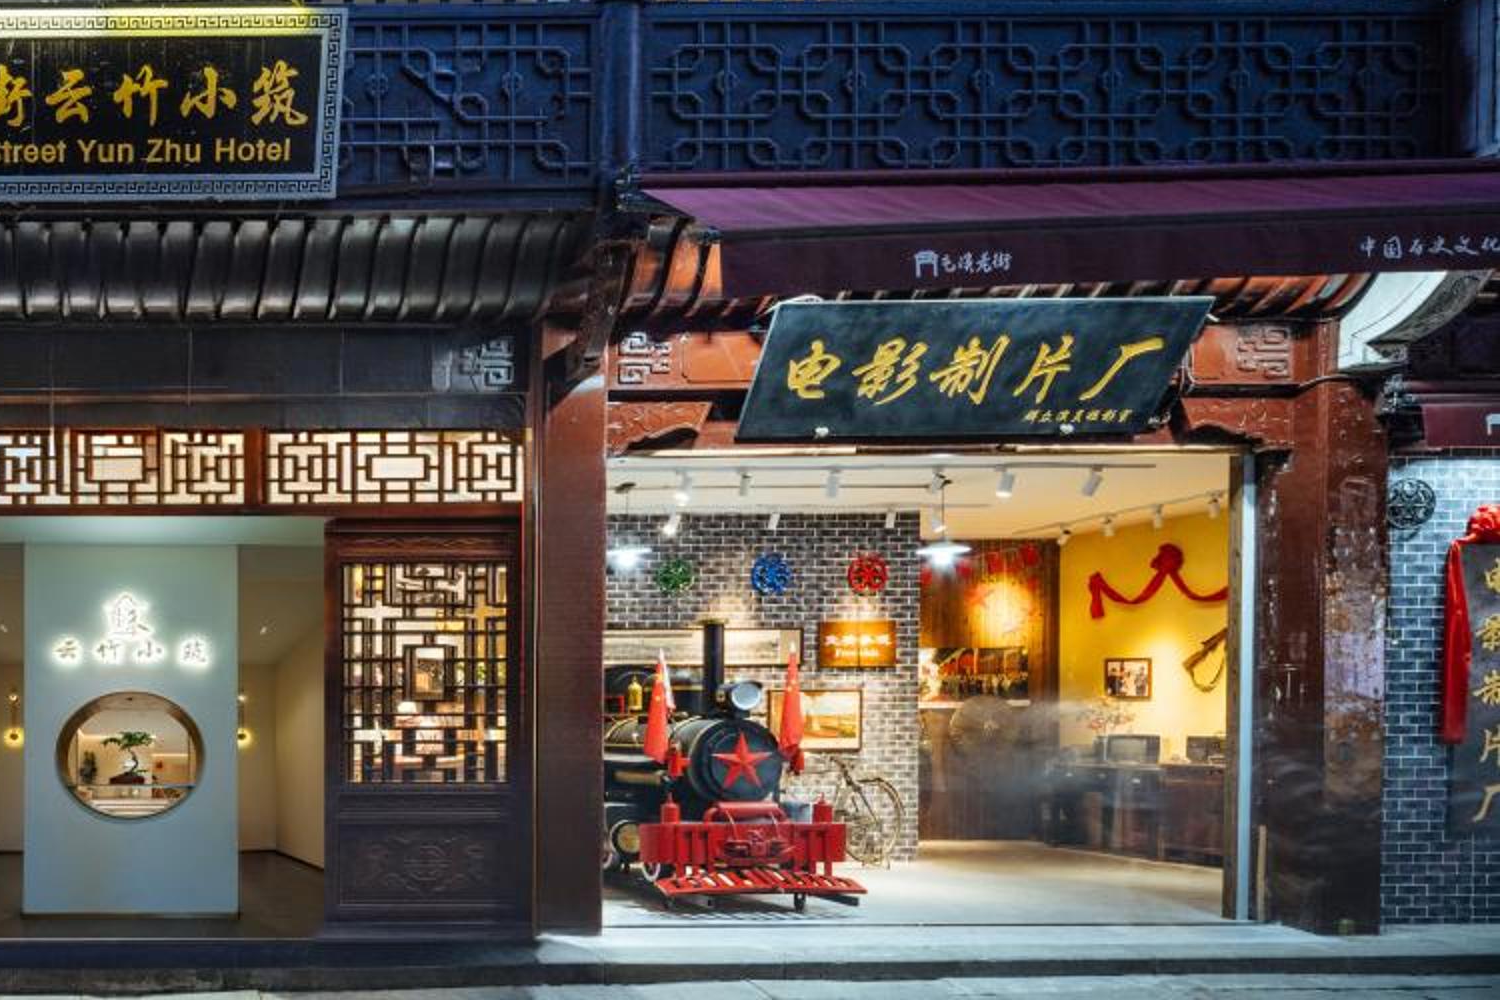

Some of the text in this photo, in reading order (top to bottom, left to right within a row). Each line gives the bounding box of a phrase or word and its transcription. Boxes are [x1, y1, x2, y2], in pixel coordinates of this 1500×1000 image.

[77, 139, 133, 163] Yun
[146, 138, 201, 163] Zhu
[214, 138, 291, 162] Hotel
[785, 332, 1165, 405] 电影制片厂
[54, 638, 209, 664] 云竹小筑
